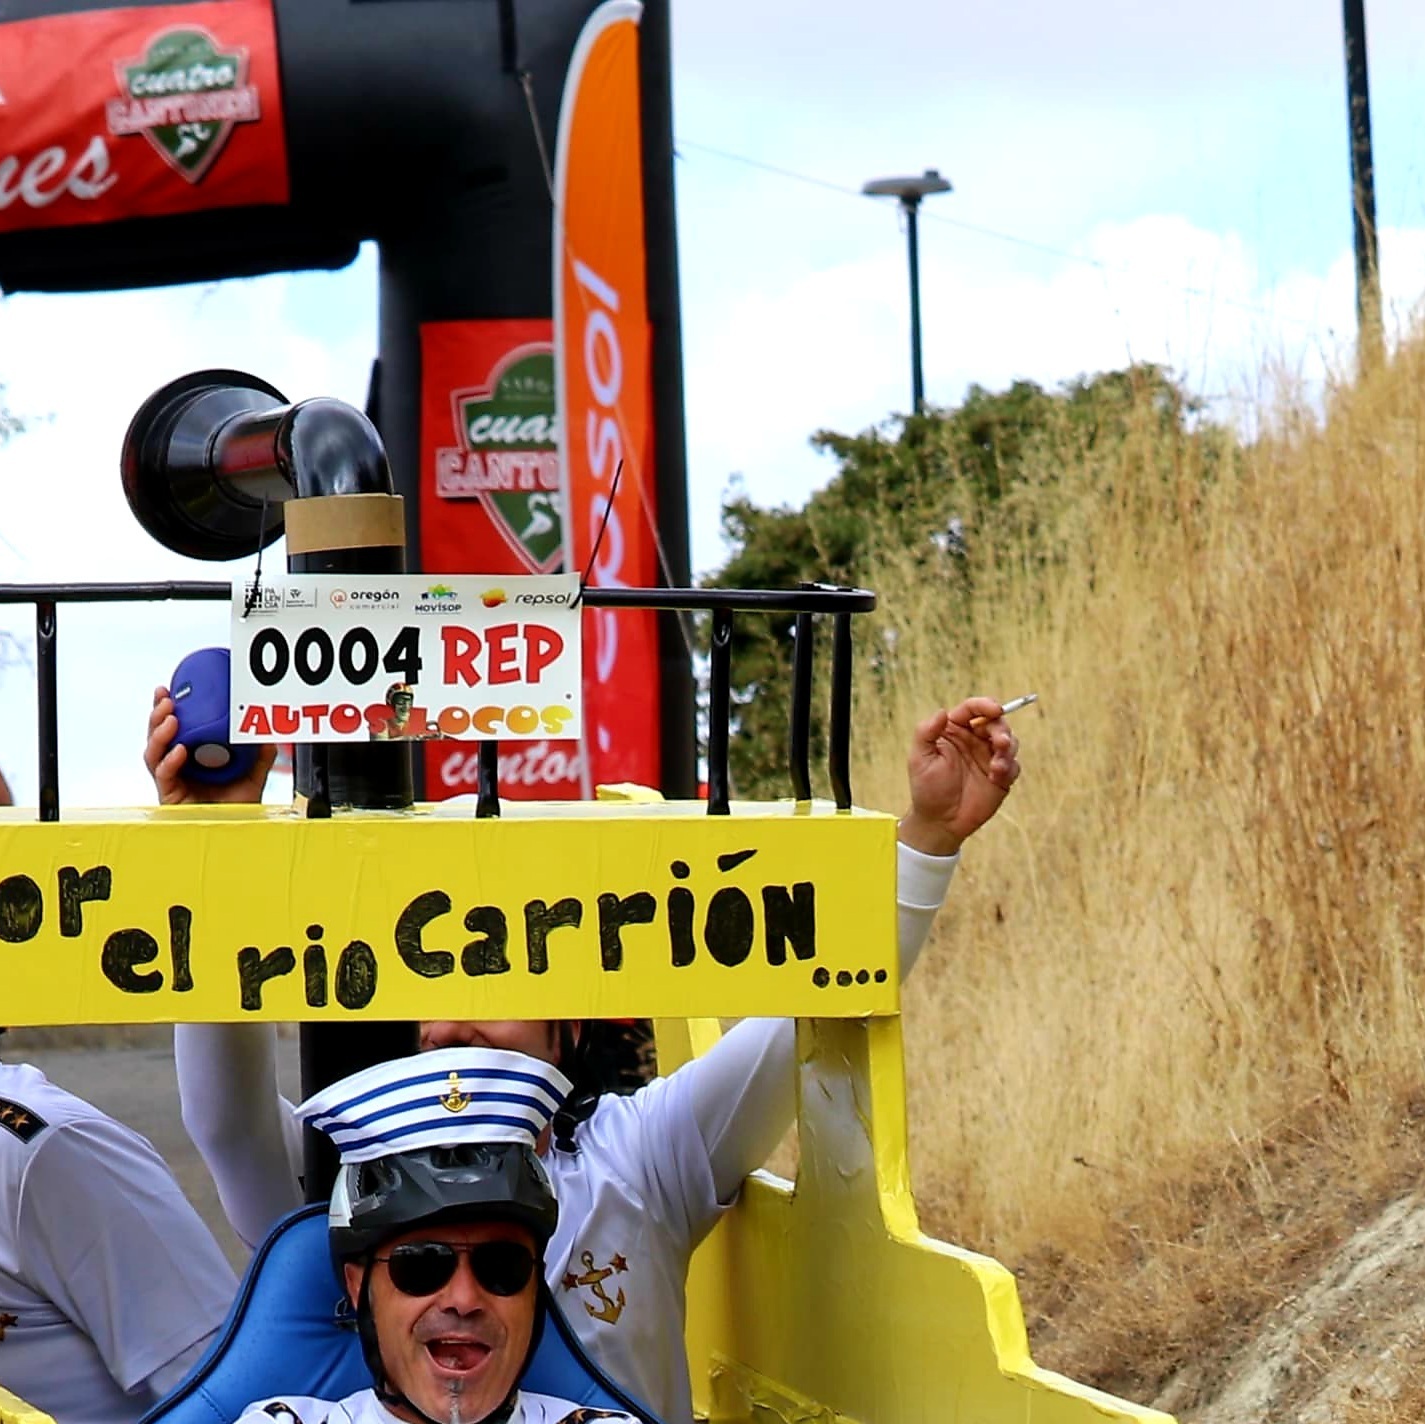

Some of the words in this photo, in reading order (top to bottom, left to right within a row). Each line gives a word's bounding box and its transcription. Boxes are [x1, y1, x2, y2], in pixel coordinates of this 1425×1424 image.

[350, 589, 400, 602] oregón
[515, 592, 571, 606] repsol
[249, 626, 423, 687] 0004
[440, 623, 565, 688] REP
[239, 703, 395, 736] AUTOS
[100, 904, 193, 993] el
[236, 923, 378, 1011] rio
